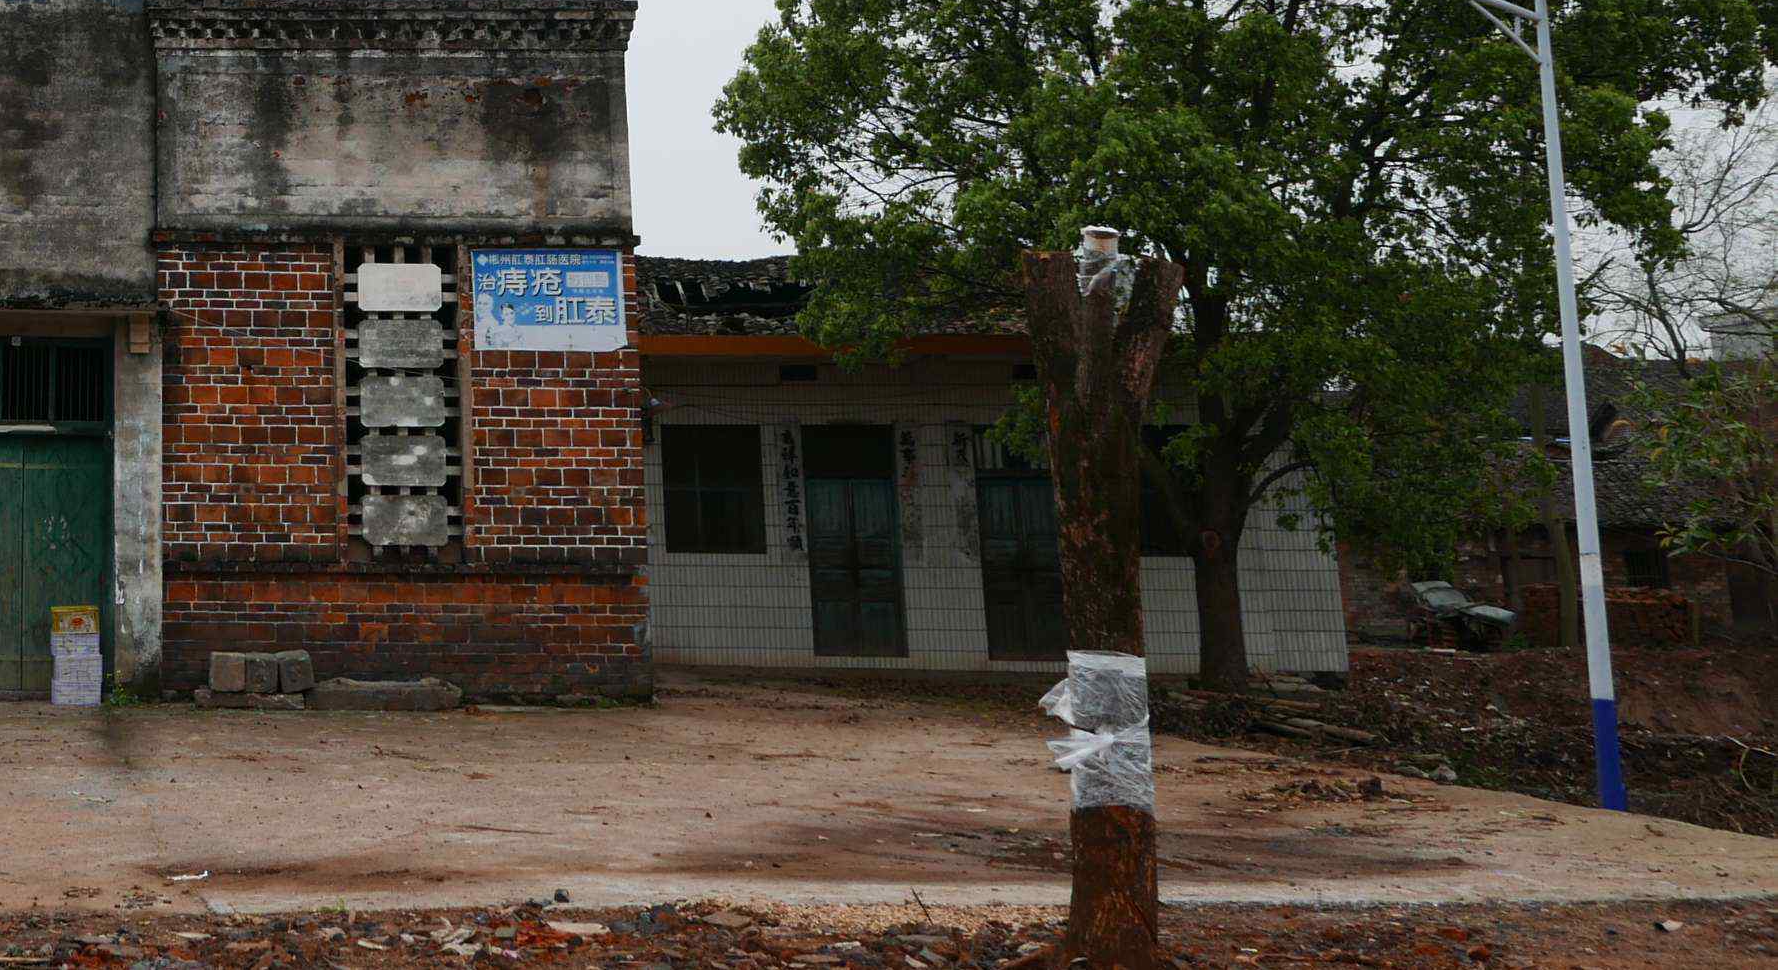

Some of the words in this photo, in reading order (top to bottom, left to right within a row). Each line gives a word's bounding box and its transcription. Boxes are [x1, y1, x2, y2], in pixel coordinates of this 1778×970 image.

[478, 268, 563, 297] 治痔疮
[535, 297, 617, 325] 到肛泰
